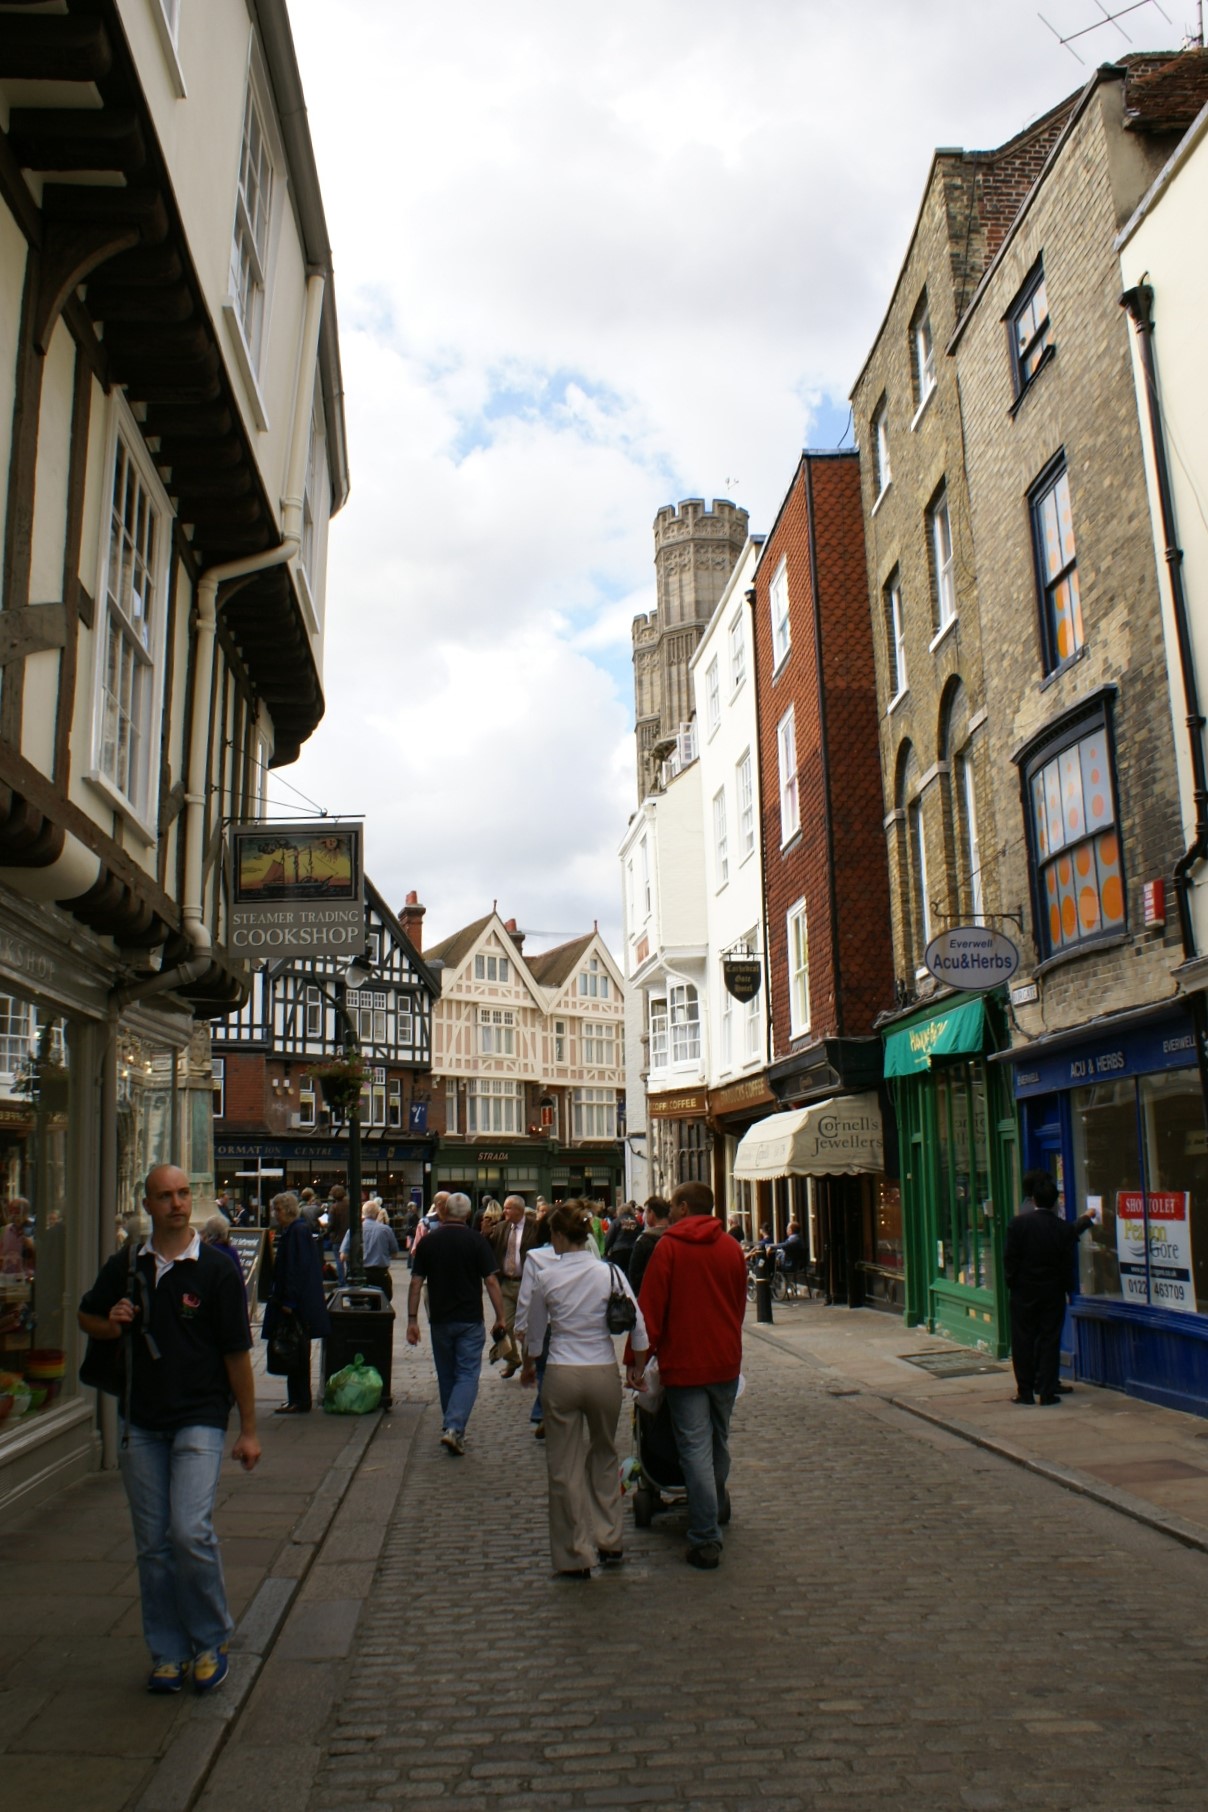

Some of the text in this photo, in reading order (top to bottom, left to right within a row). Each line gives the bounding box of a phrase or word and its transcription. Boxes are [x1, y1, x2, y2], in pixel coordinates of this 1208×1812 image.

[232, 910, 359, 925] STEAMER TRADING
[232, 926, 359, 947] COOKSHOP
[949, 939, 993, 949] Everwell
[0, 936, 55, 981] KSHOP
[933, 953, 1012, 970] Acu&Herbs
[1070, 1051, 1125, 1079] ACU & HERBS
[818, 1115, 879, 1139] Cornell's
[811, 1135, 884, 1157] Jewellers
[478, 1152, 508, 1160] STRADA
[1125, 1198, 1145, 1213] SHO
[1160, 1198, 1175, 1214] LET
[1149, 1236, 1179, 1259] Gore
[1153, 1282, 1185, 1300] 463709
